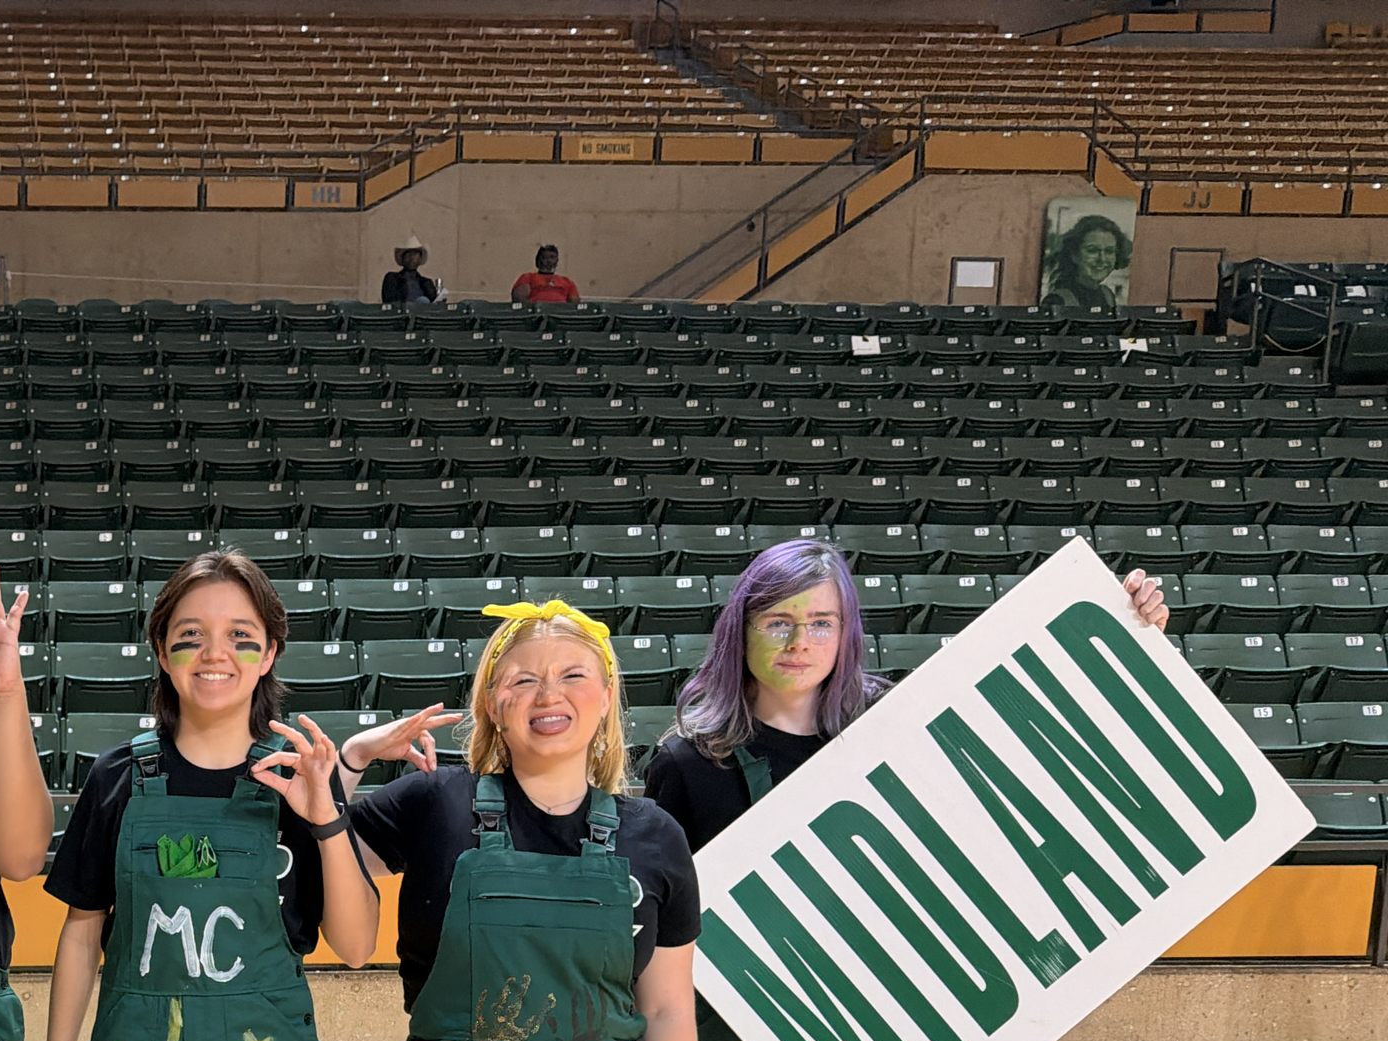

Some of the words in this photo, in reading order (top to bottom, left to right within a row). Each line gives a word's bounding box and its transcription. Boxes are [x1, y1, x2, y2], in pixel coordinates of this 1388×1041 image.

[582, 143, 592, 154] NO
[596, 143, 631, 155] SMOKING
[312, 186, 341, 204] HH
[1183, 191, 1211, 209] JJ
[636, 637, 649, 648] 10
[1247, 638, 1260, 646] 16
[1348, 637, 1361, 646] 17
[1257, 708, 1269, 717] 15
[1365, 706, 1380, 715] 16
[139, 902, 246, 983] MC
